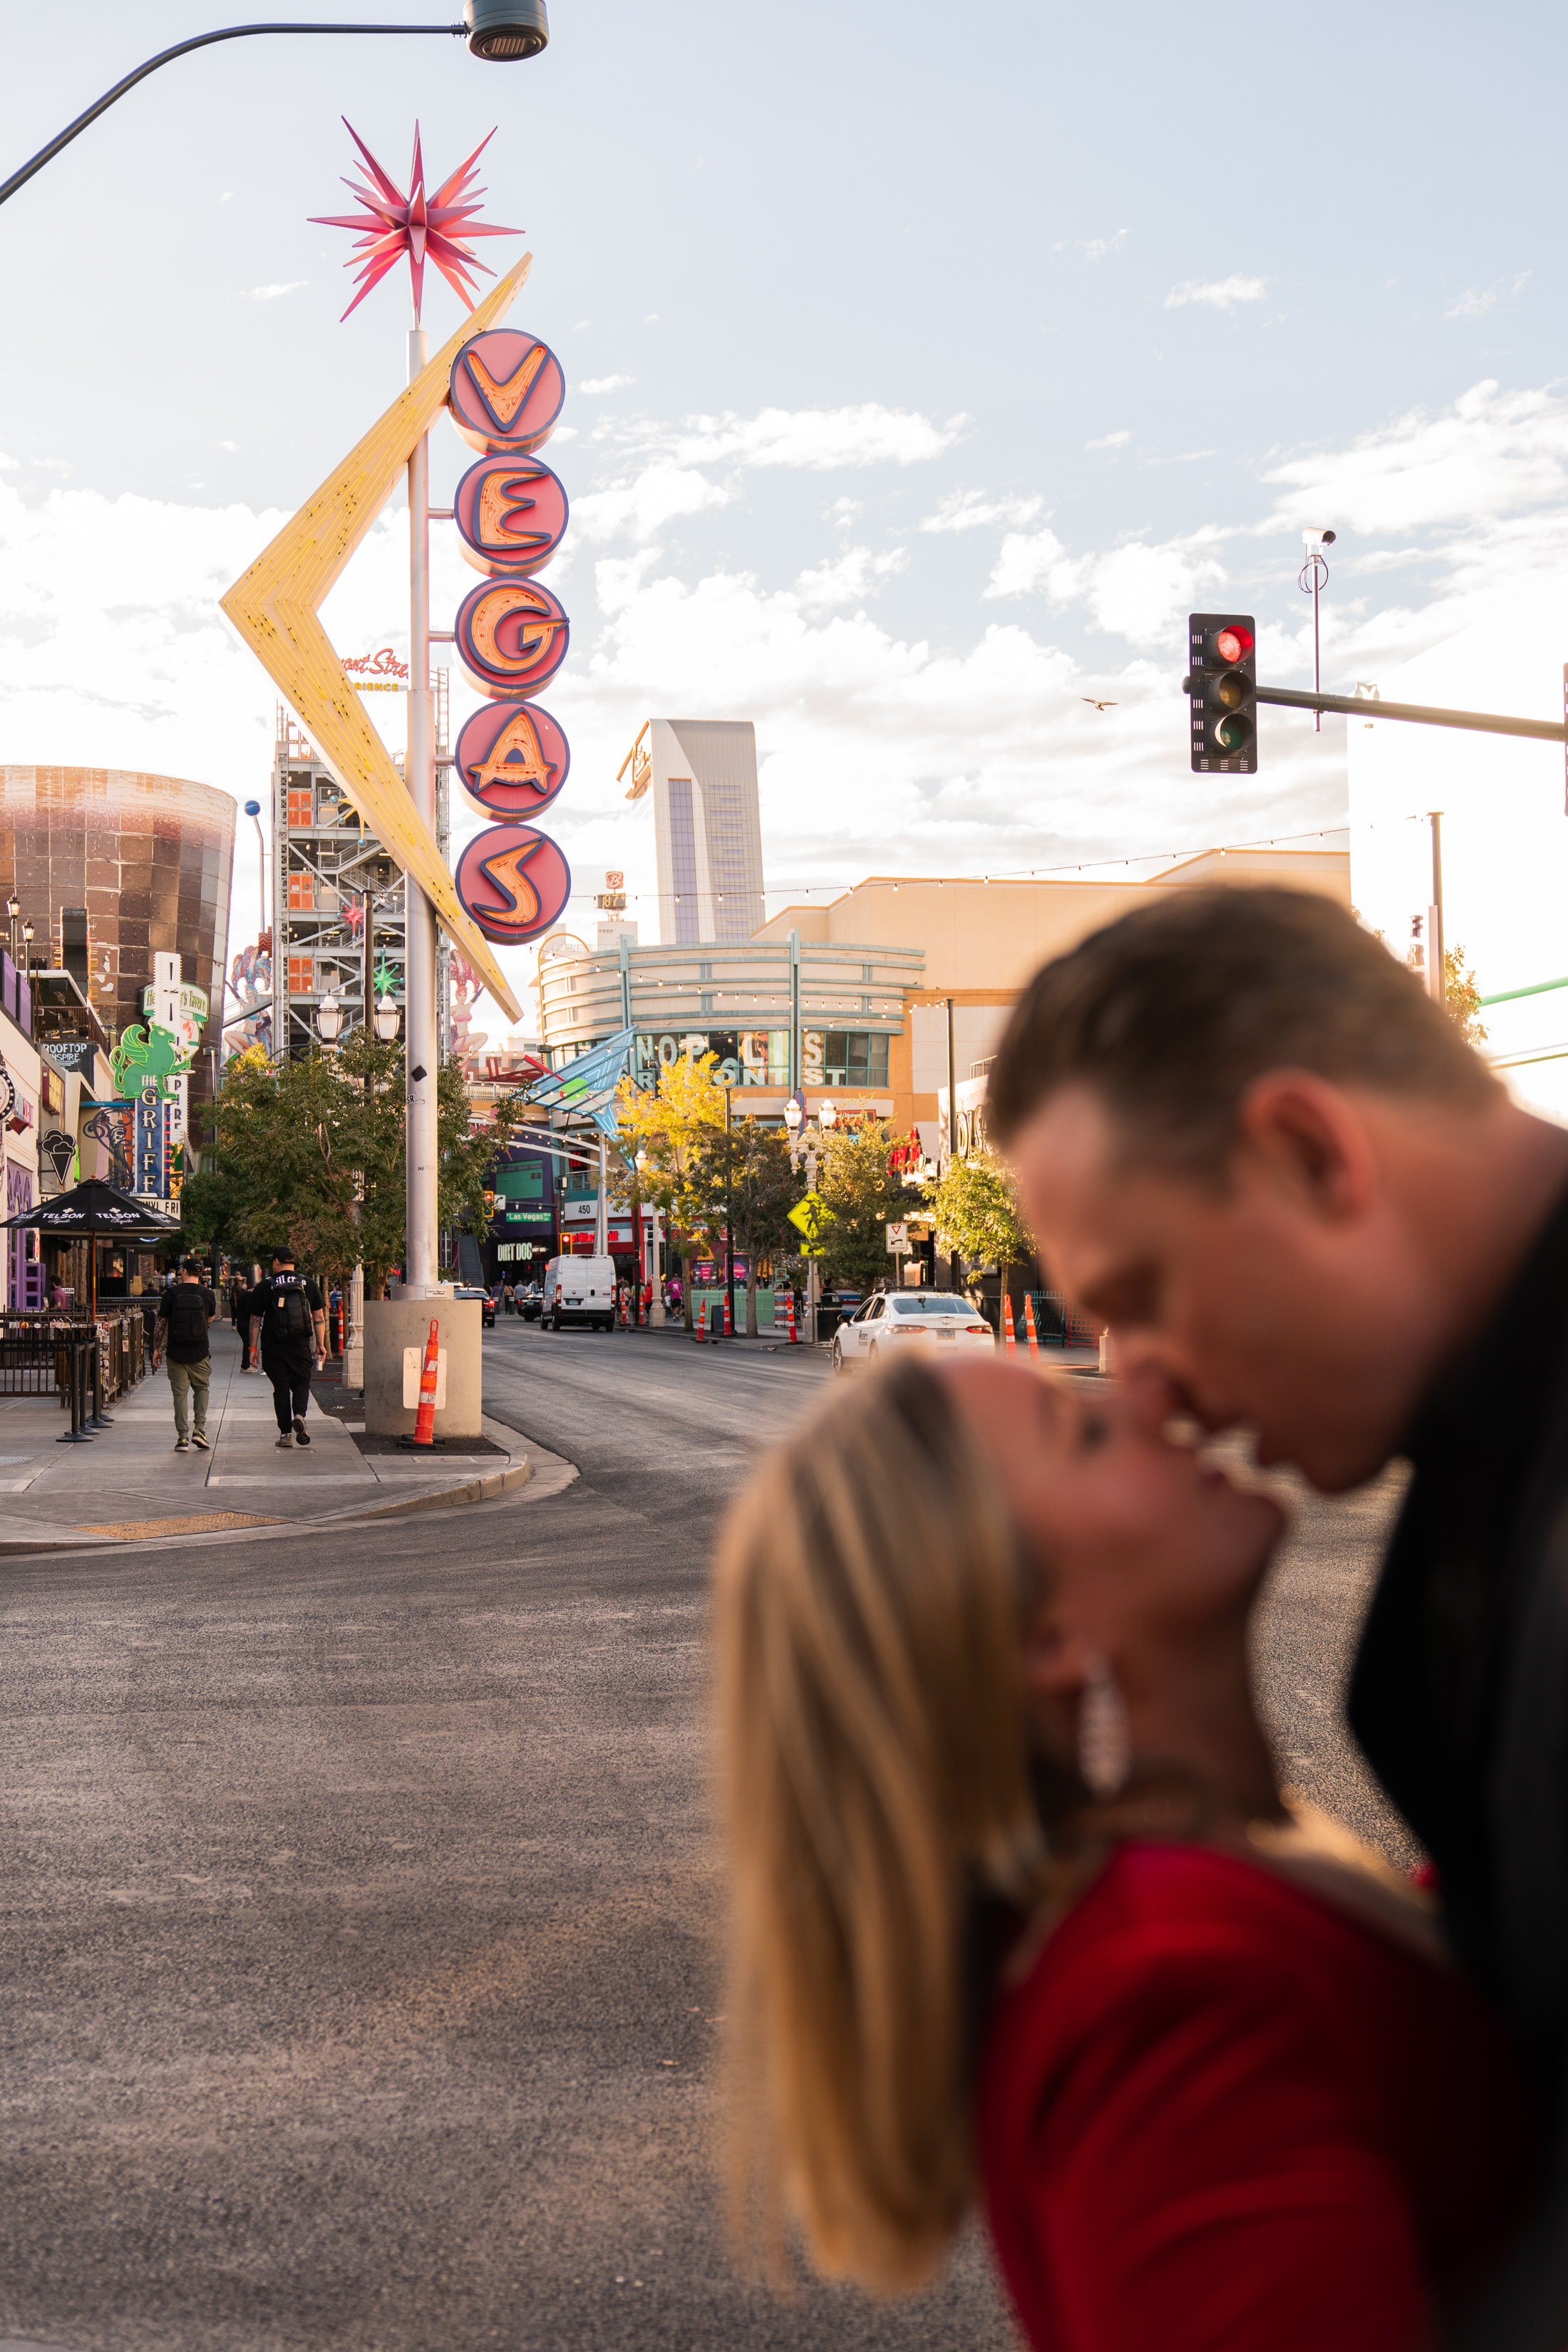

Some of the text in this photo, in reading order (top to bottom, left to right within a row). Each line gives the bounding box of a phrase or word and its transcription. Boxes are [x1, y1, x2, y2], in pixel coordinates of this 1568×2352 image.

[462, 341, 570, 927] VEGAS
[43, 1043, 87, 1054] ROOFTOP
[141, 1075, 158, 1086] THE
[141, 1087, 159, 1193] GRIFF
[165, 1202, 179, 1214] FRI
[578, 1205, 591, 1214] 450
[522, 1213, 543, 1222] Vegas
[497, 1242, 532, 1262] DIRT DOG
